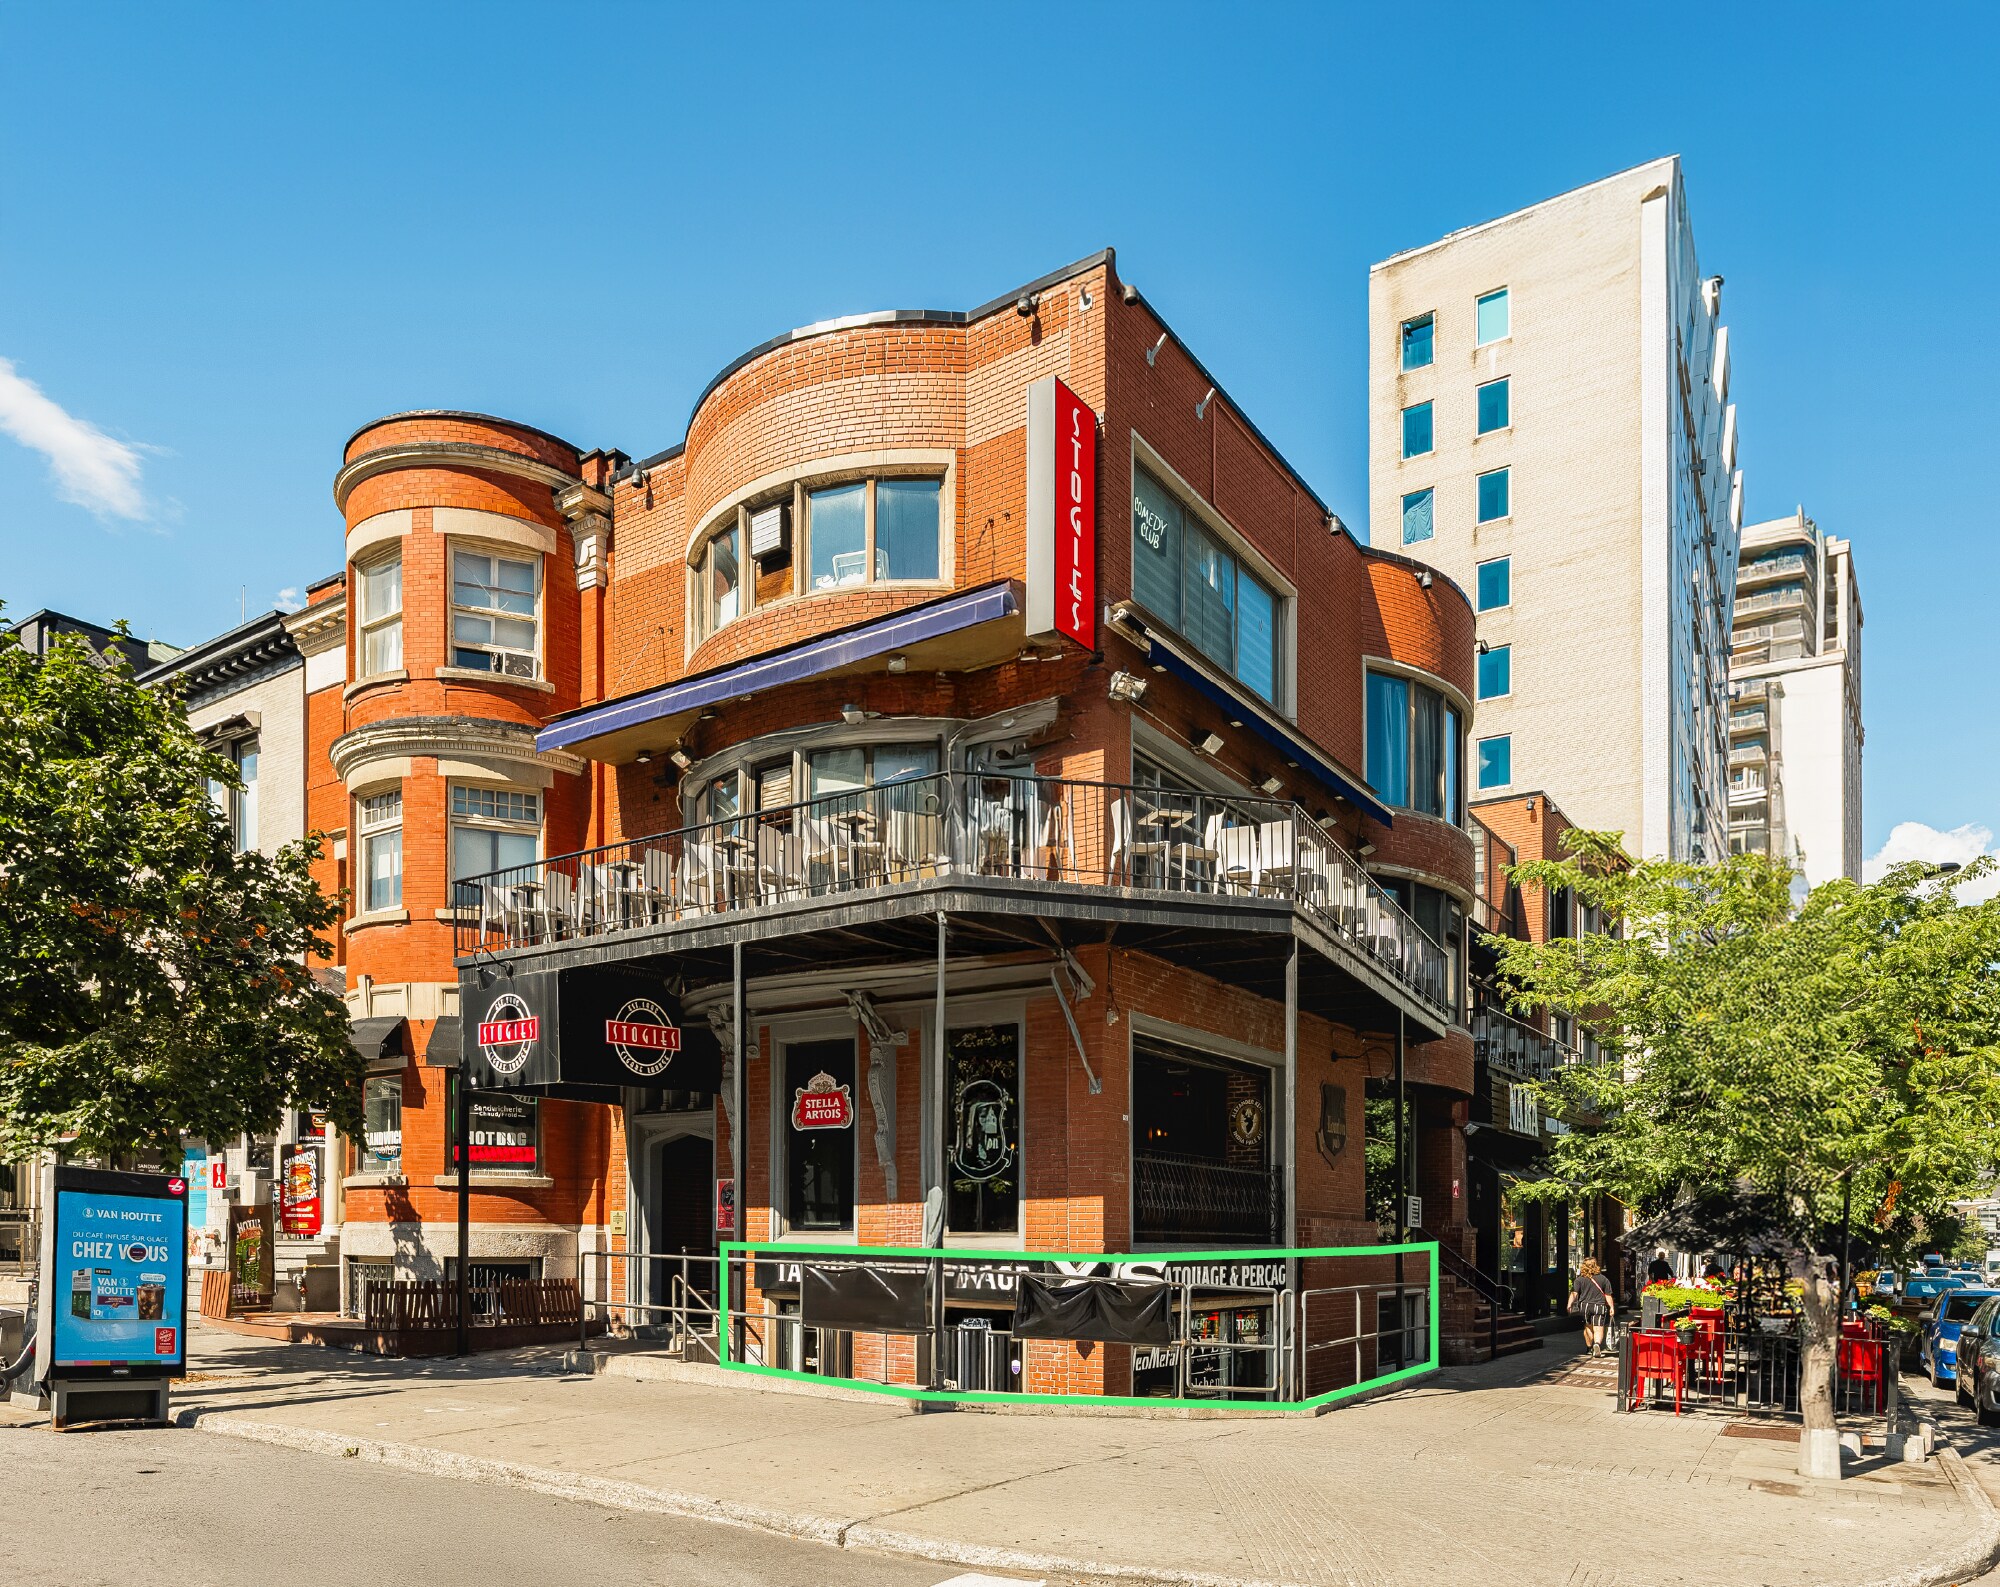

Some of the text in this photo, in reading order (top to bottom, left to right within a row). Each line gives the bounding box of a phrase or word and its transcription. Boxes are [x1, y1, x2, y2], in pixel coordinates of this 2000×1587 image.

[1069, 407, 1082, 631] STOGIES
[1135, 496, 1168, 536] COMEDY
[1140, 522, 1160, 549] CLUB
[483, 1022, 533, 1043] STOGIES
[613, 1024, 676, 1047] STOGIES
[473, 1104, 523, 1113] Sandwicherie
[805, 1097, 840, 1109] STELLA
[805, 1108, 841, 1119] ARTOIS
[96, 1209, 163, 1222] VAN HOUTTE
[86, 1231, 103, 1239] CAFÉ
[131, 1234, 145, 1242] SUR
[72, 1241, 169, 1263] CHEZ VOUS
[97, 1277, 118, 1286] VAN
[1163, 1265, 1227, 1290] ATOUAGE
[1229, 1265, 1239, 1287] &
[1241, 1263, 1286, 1289] PERÇAG
[97, 1286, 135, 1296] HOUTTE
